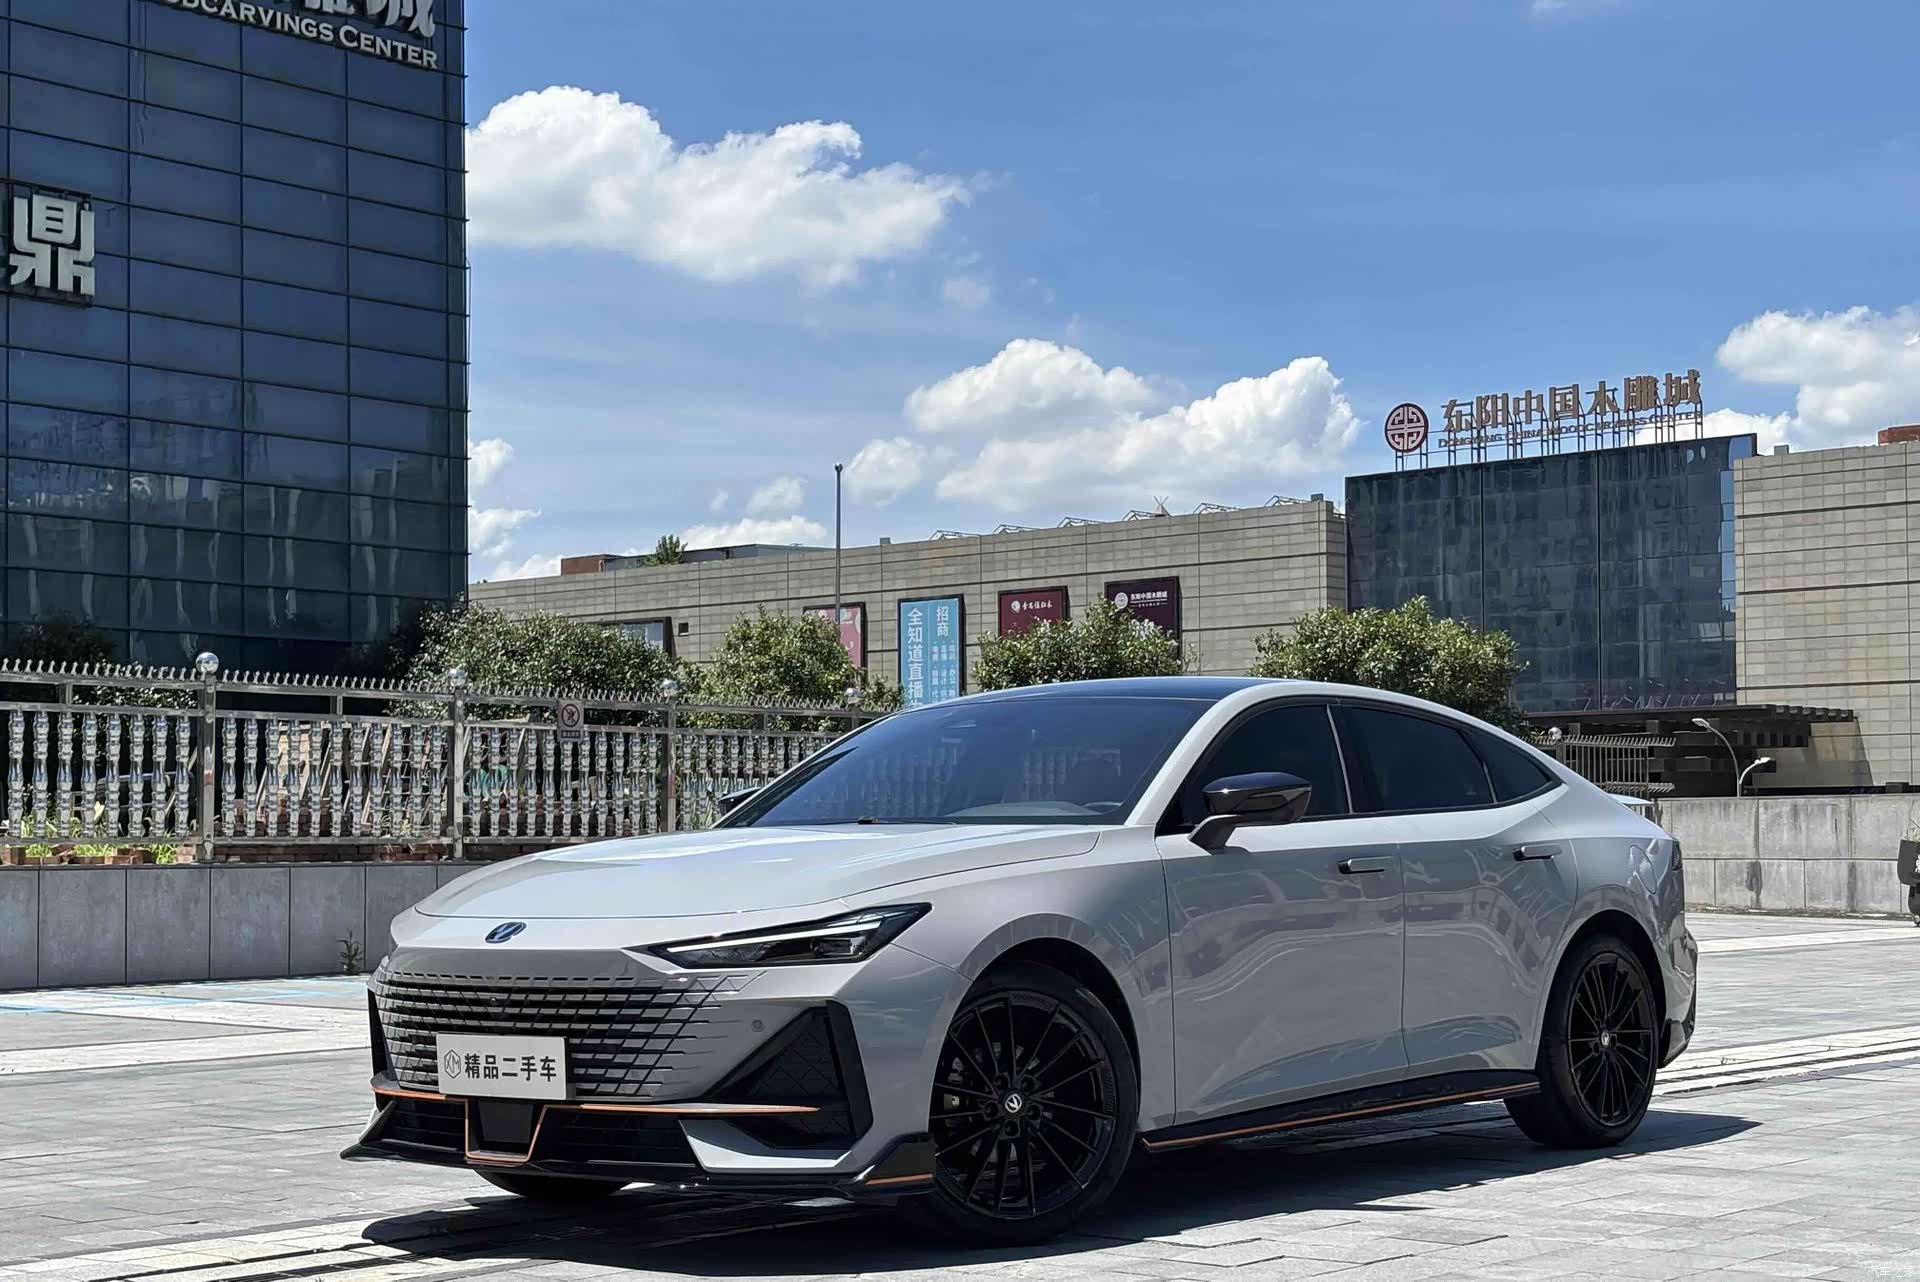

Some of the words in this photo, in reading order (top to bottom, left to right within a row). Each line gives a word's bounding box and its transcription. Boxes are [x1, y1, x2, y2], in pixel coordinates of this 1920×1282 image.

[9, 194, 95, 296] 鼎
[1440, 369, 1702, 432] 东阳中国木雕城
[936, 606, 949, 637] 招商
[464, 1053, 557, 1082] 精品二手车
